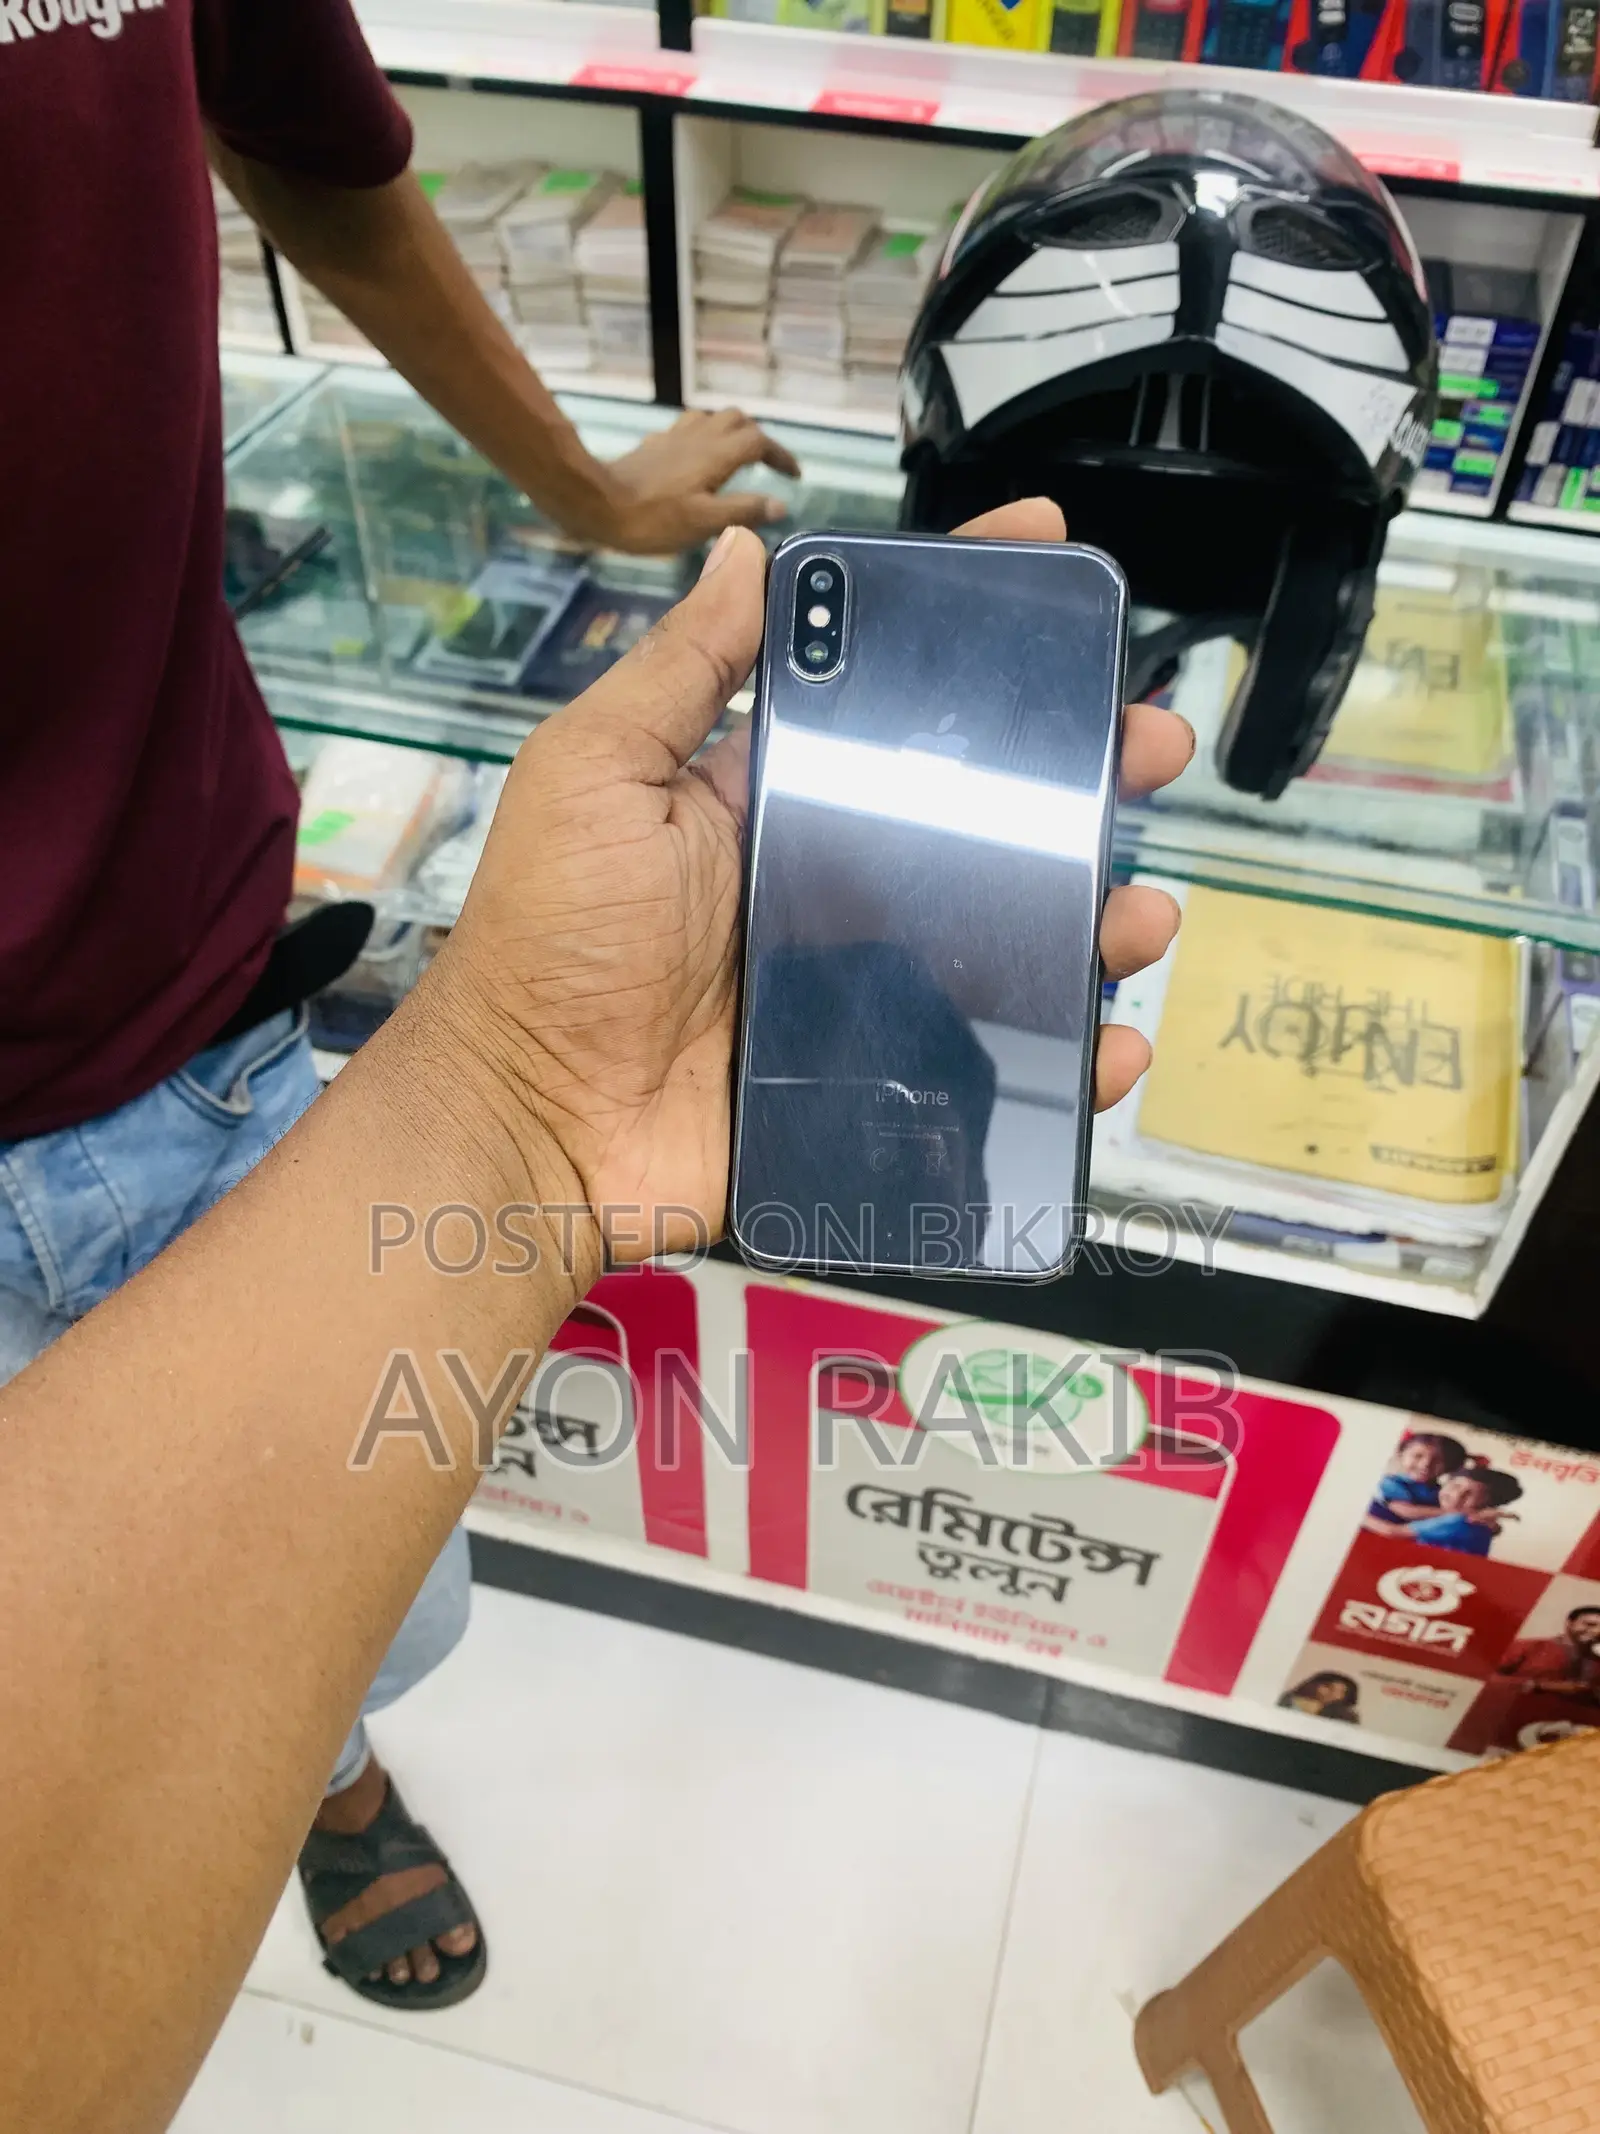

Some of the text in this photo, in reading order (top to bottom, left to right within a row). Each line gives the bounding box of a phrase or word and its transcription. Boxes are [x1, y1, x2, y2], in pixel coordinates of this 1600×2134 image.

[875, 1080, 949, 1106] iPhone
[846, 1482, 1162, 1586] রেমিটেন্স
[917, 1540, 1073, 1603] তুলুন
[1340, 1598, 1475, 1653] নগদ
